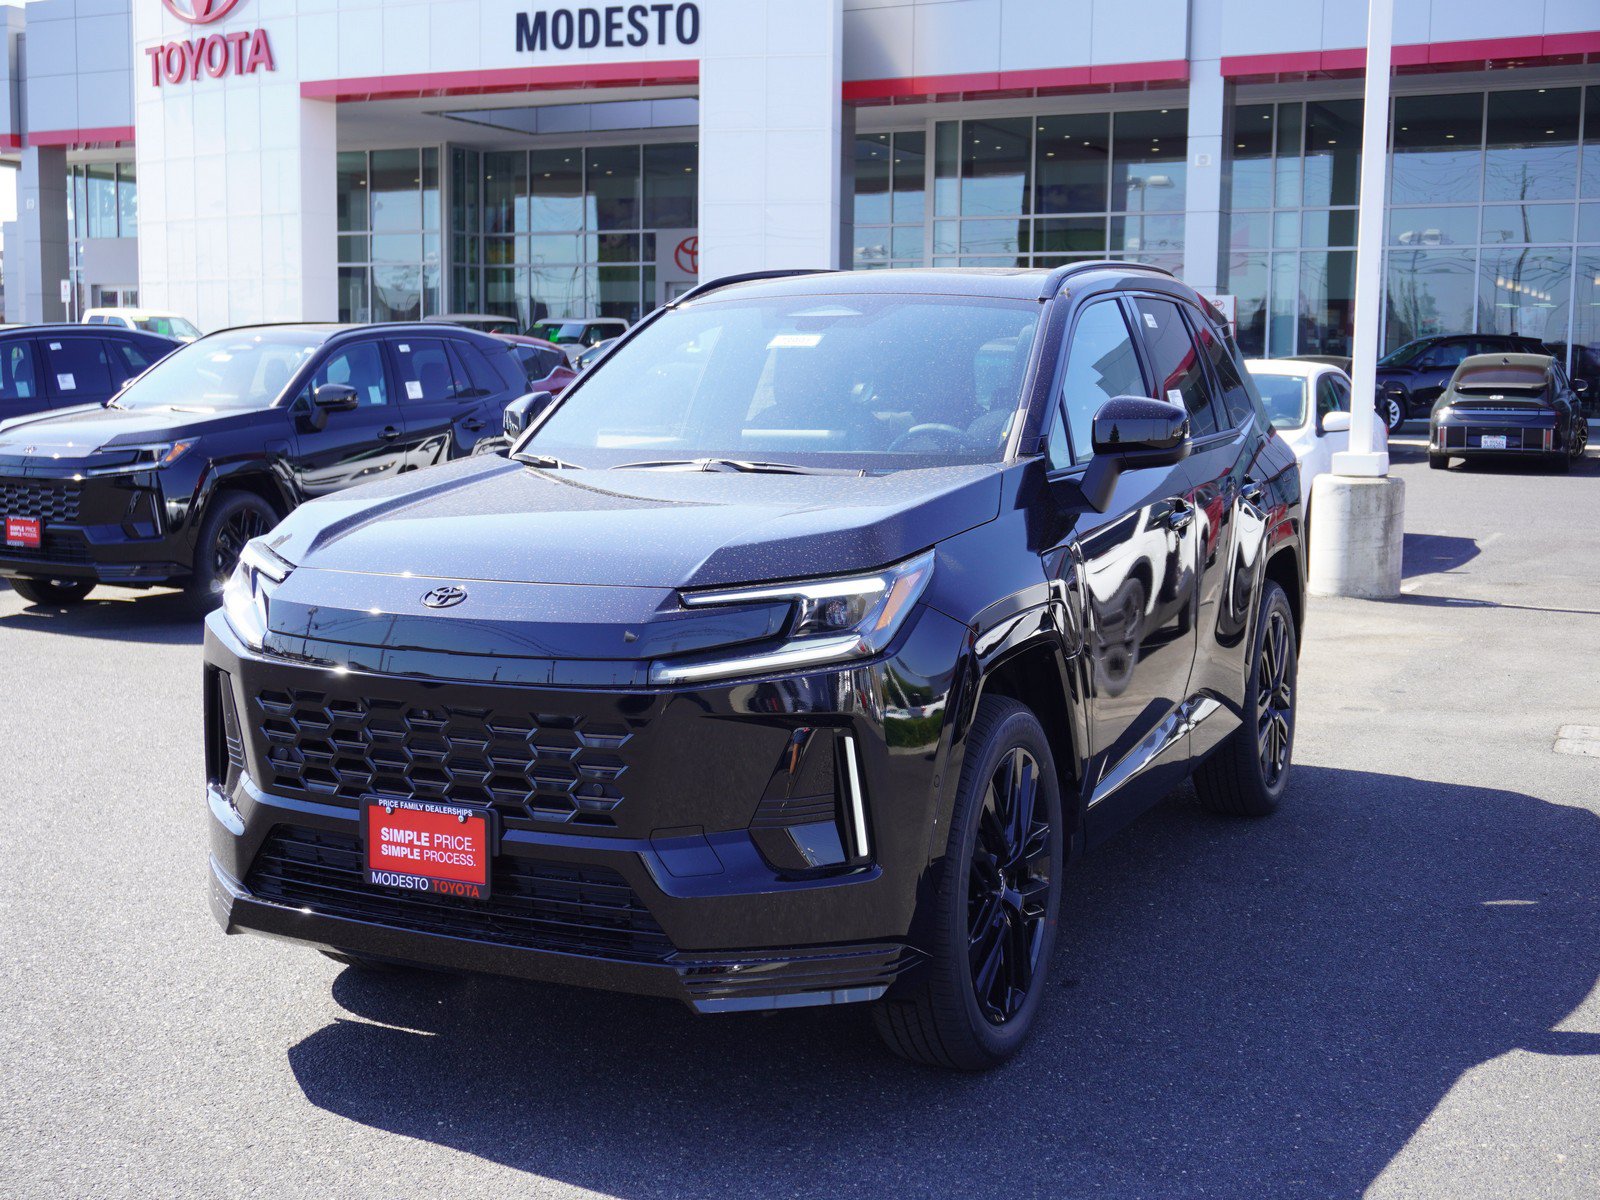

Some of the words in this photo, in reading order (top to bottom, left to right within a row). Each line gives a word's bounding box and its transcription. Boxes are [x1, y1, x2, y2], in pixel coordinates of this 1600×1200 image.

[516, 2, 700, 52] MODESTO
[145, 28, 275, 87] TOYOTA
[378, 799, 399, 808] PRICE
[400, 801, 424, 811] FAMILY
[425, 805, 473, 817] DEALERSHIPS
[381, 827, 430, 846] SIMPLE
[433, 833, 476, 852] PRICE.
[381, 844, 421, 860] SIMPLE
[423, 849, 477, 867] PROCESS.
[371, 871, 429, 890] MODESTO
[432, 880, 480, 898] TOYOTA
